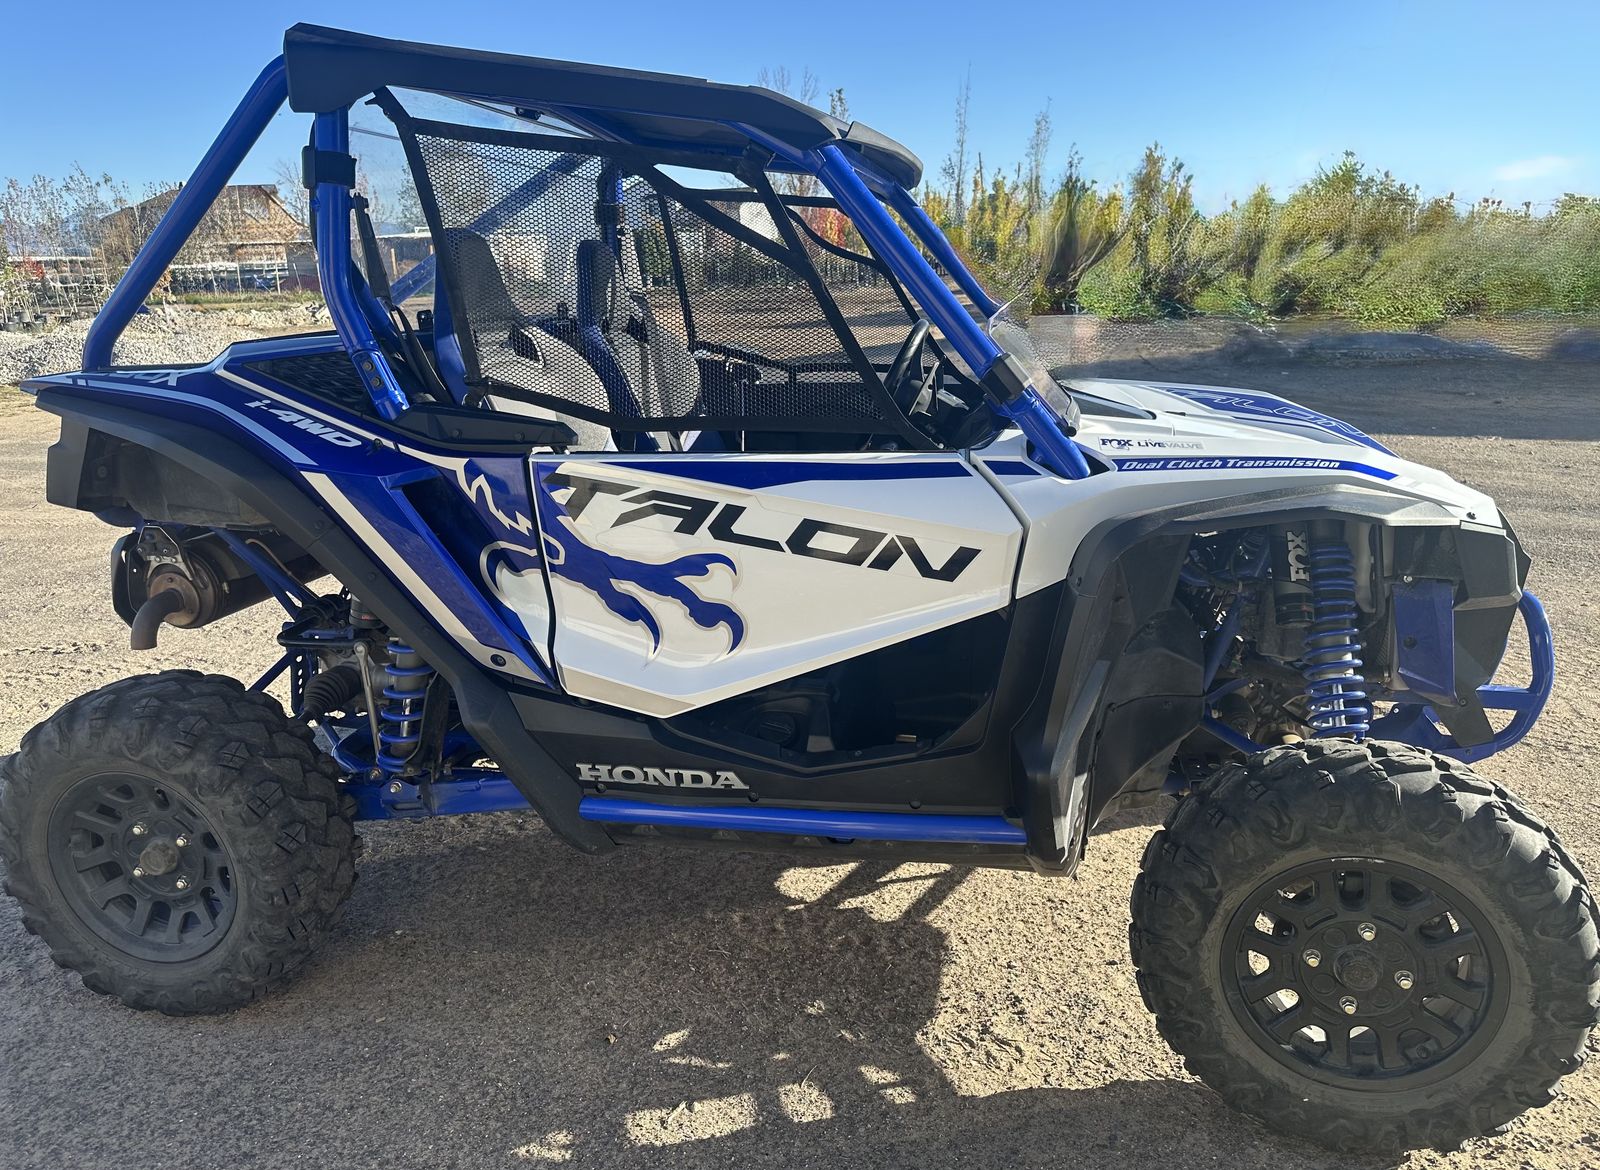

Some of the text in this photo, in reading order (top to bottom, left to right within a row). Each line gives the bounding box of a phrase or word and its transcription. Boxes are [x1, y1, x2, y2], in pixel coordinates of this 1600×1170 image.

[244, 400, 362, 447] i-4WD
[1100, 438, 1134, 451] FOX
[1122, 458, 1340, 470] Dual Clutch Transmission
[543, 472, 982, 583] TALON
[1286, 531, 1311, 582] FOX
[576, 763, 750, 790] HONDA
